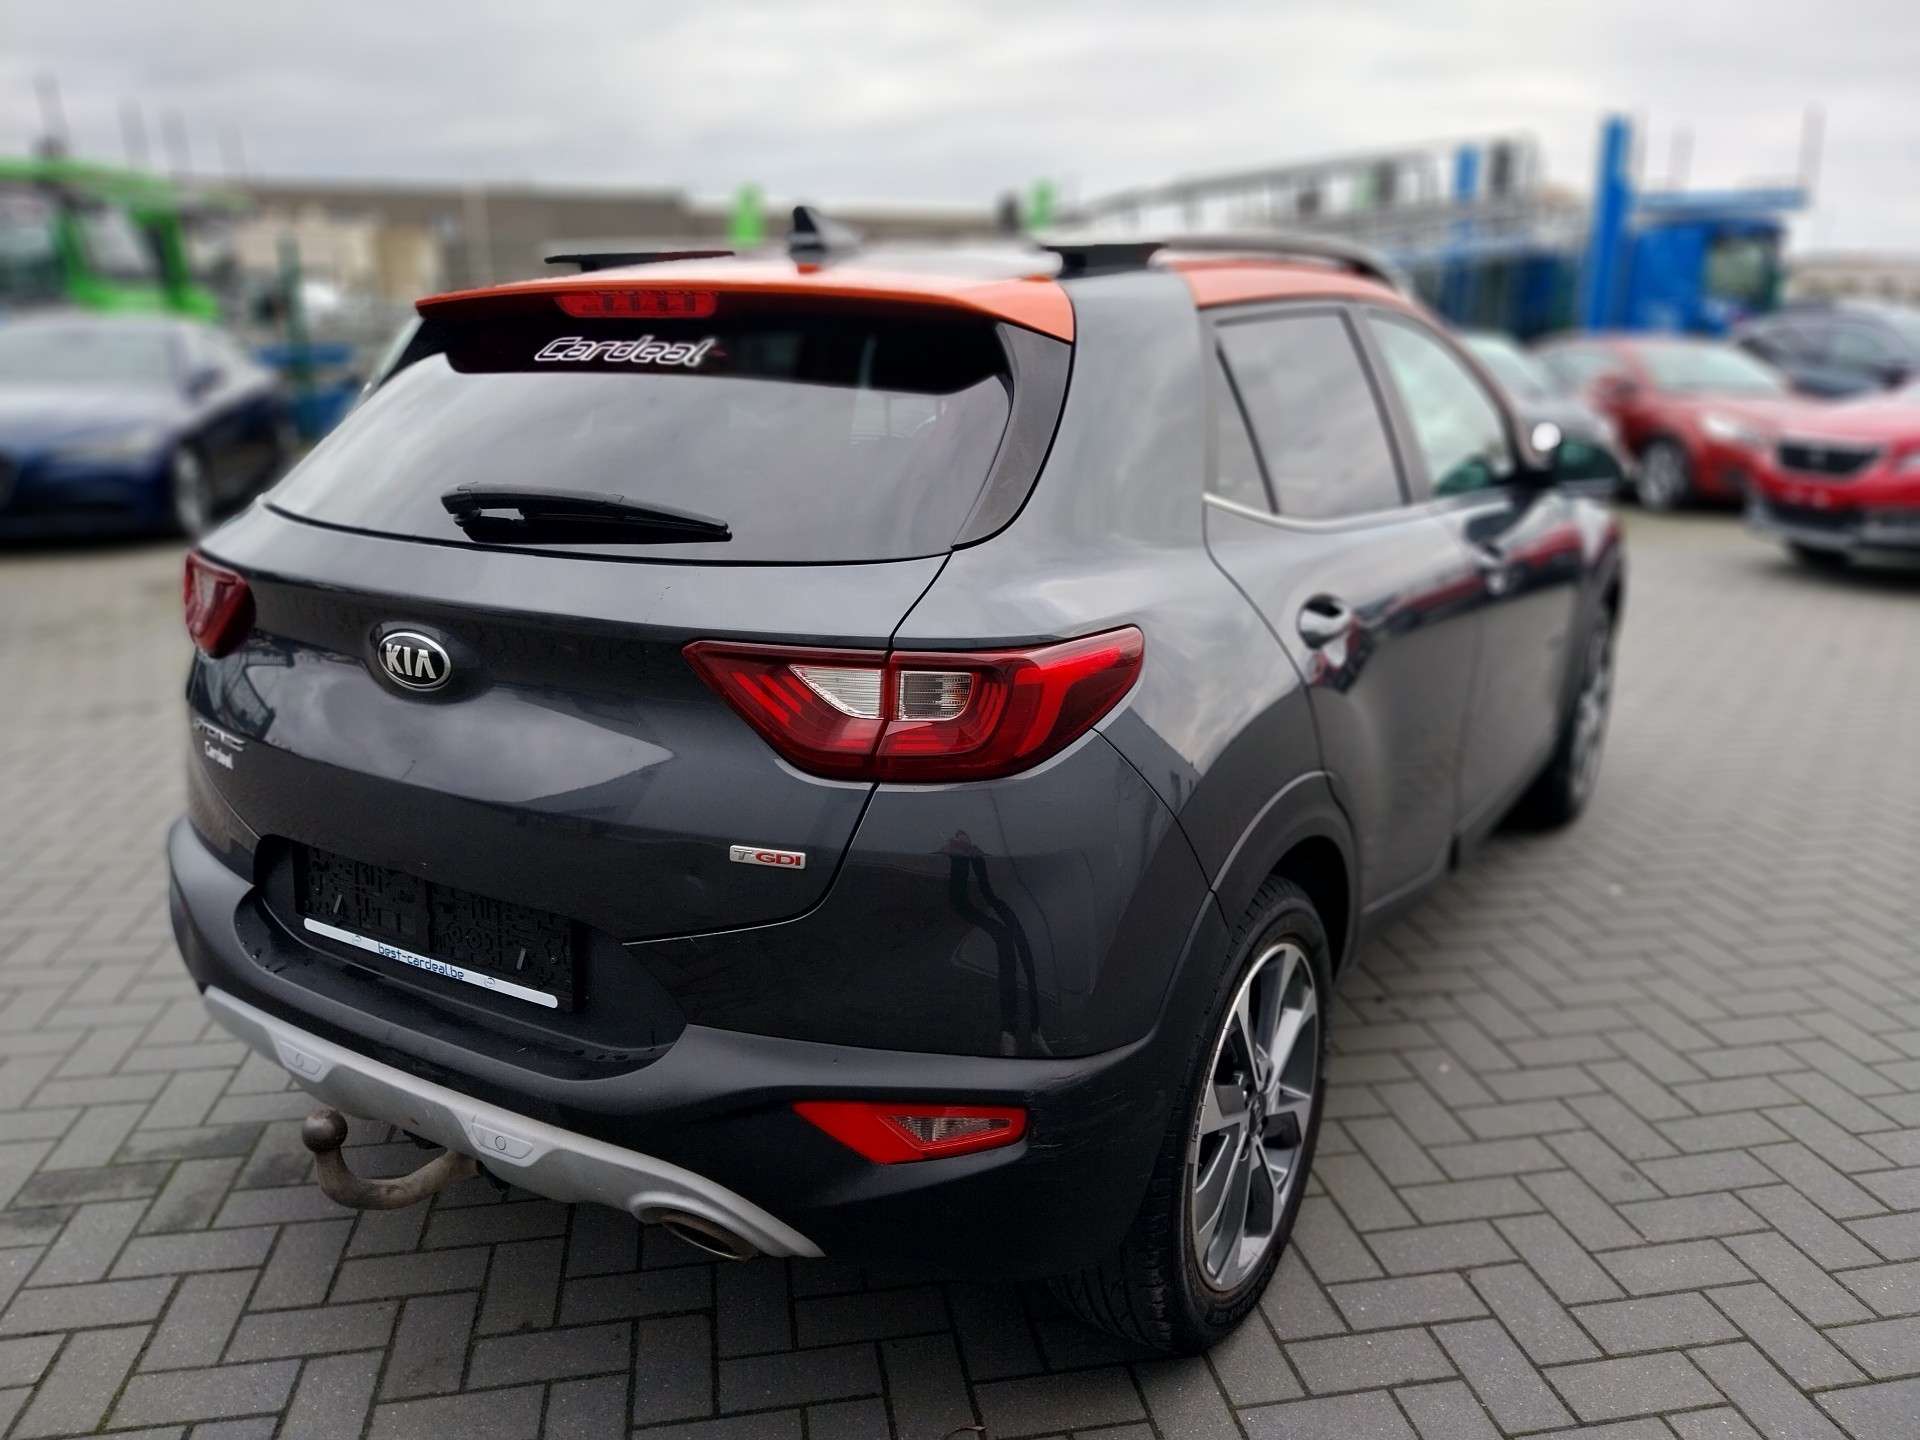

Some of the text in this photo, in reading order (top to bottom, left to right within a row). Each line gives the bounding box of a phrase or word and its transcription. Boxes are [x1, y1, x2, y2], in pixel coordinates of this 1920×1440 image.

[534, 335, 716, 367] Cardeal
[385, 643, 437, 679] KIA
[377, 942, 465, 980] best-cardeal.be
